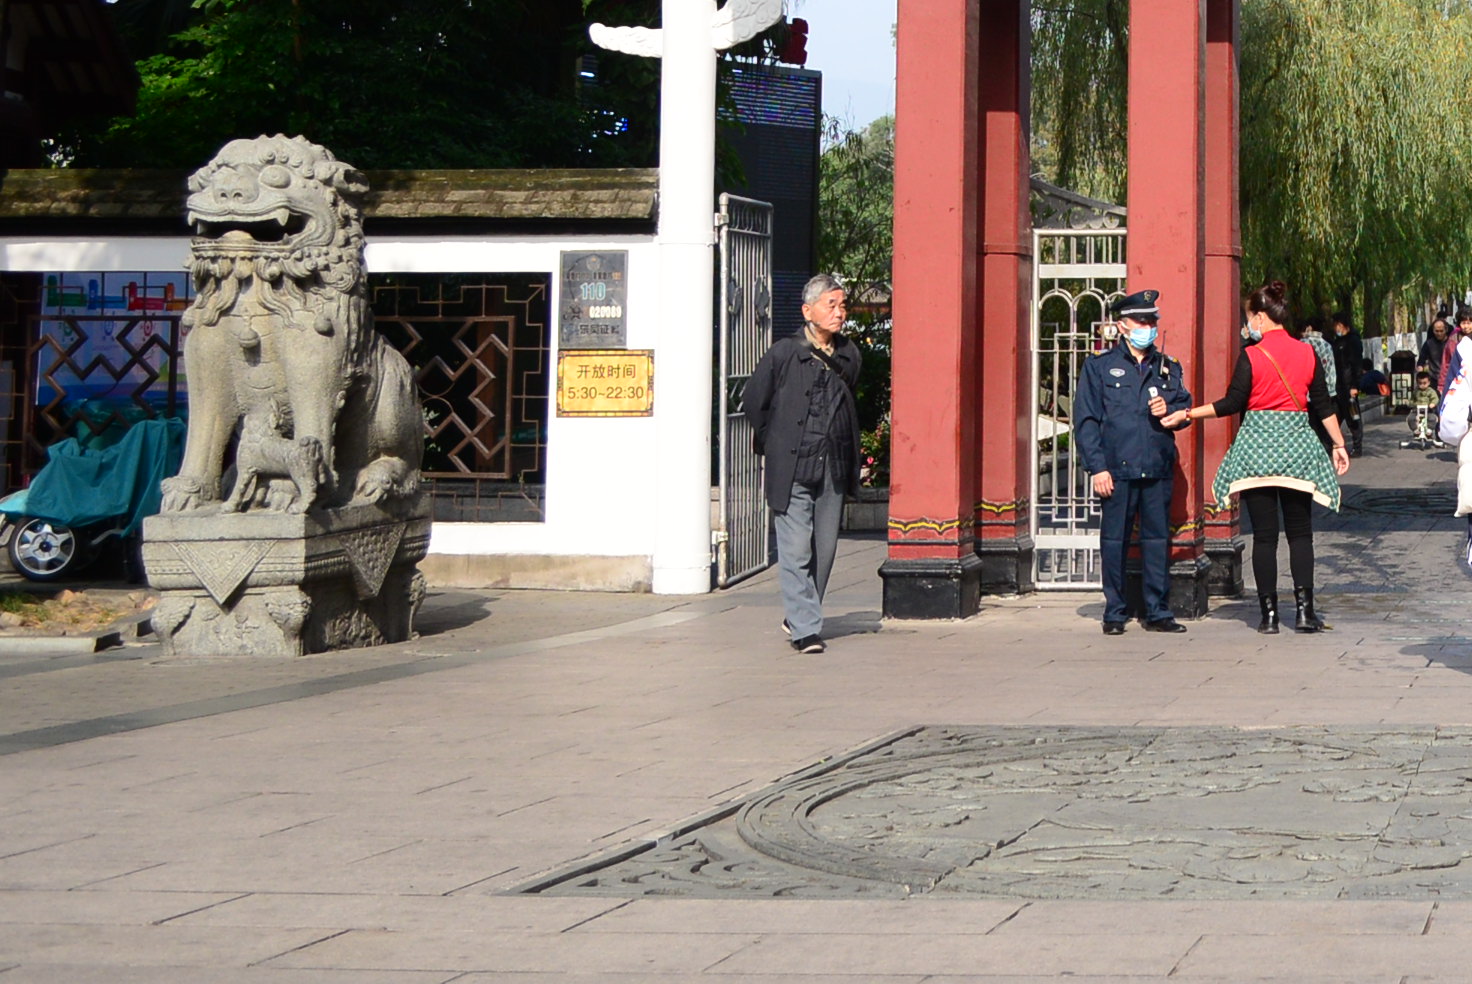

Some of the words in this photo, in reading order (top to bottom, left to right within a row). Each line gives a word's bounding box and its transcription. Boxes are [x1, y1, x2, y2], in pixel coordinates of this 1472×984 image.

[580, 282, 606, 301] 110
[577, 363, 636, 379] 开放时间
